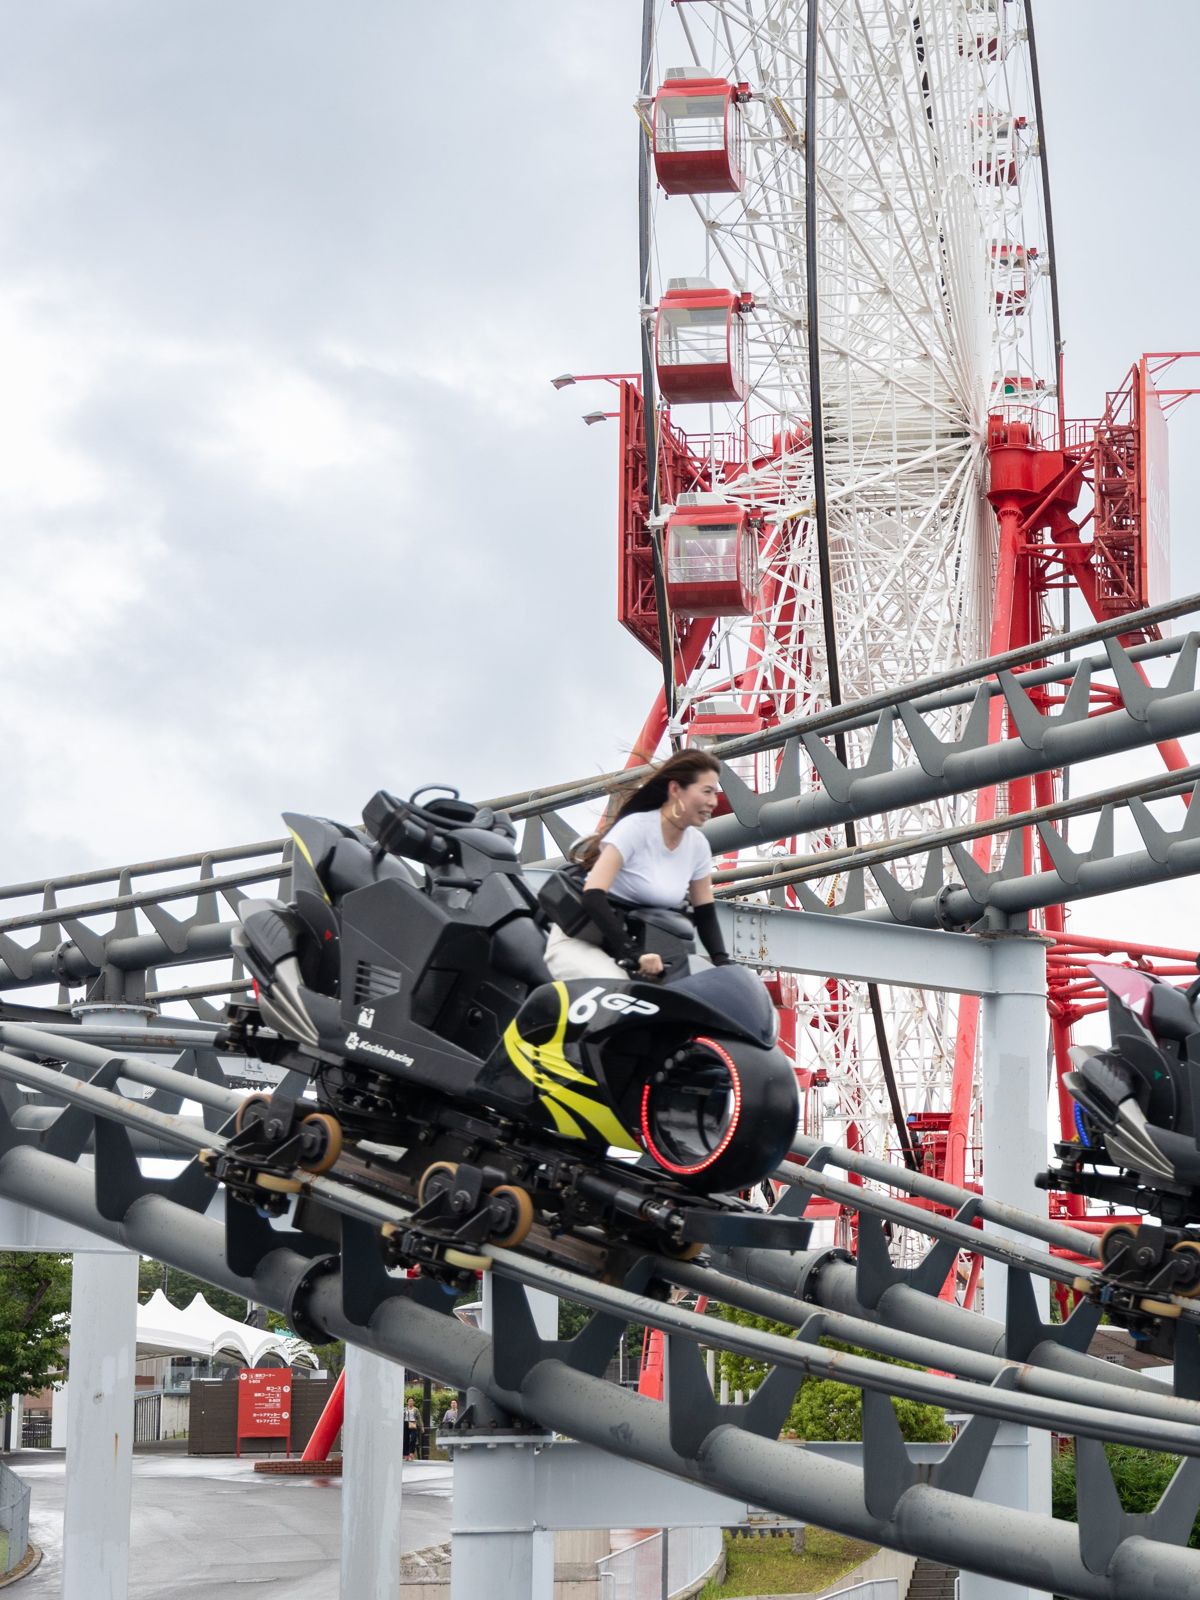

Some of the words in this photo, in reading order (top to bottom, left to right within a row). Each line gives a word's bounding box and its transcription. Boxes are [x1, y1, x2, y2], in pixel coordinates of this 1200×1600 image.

[568, 986, 606, 1024] 6
[601, 993, 660, 1015] GP
[386, 1050, 415, 1067] Racing
